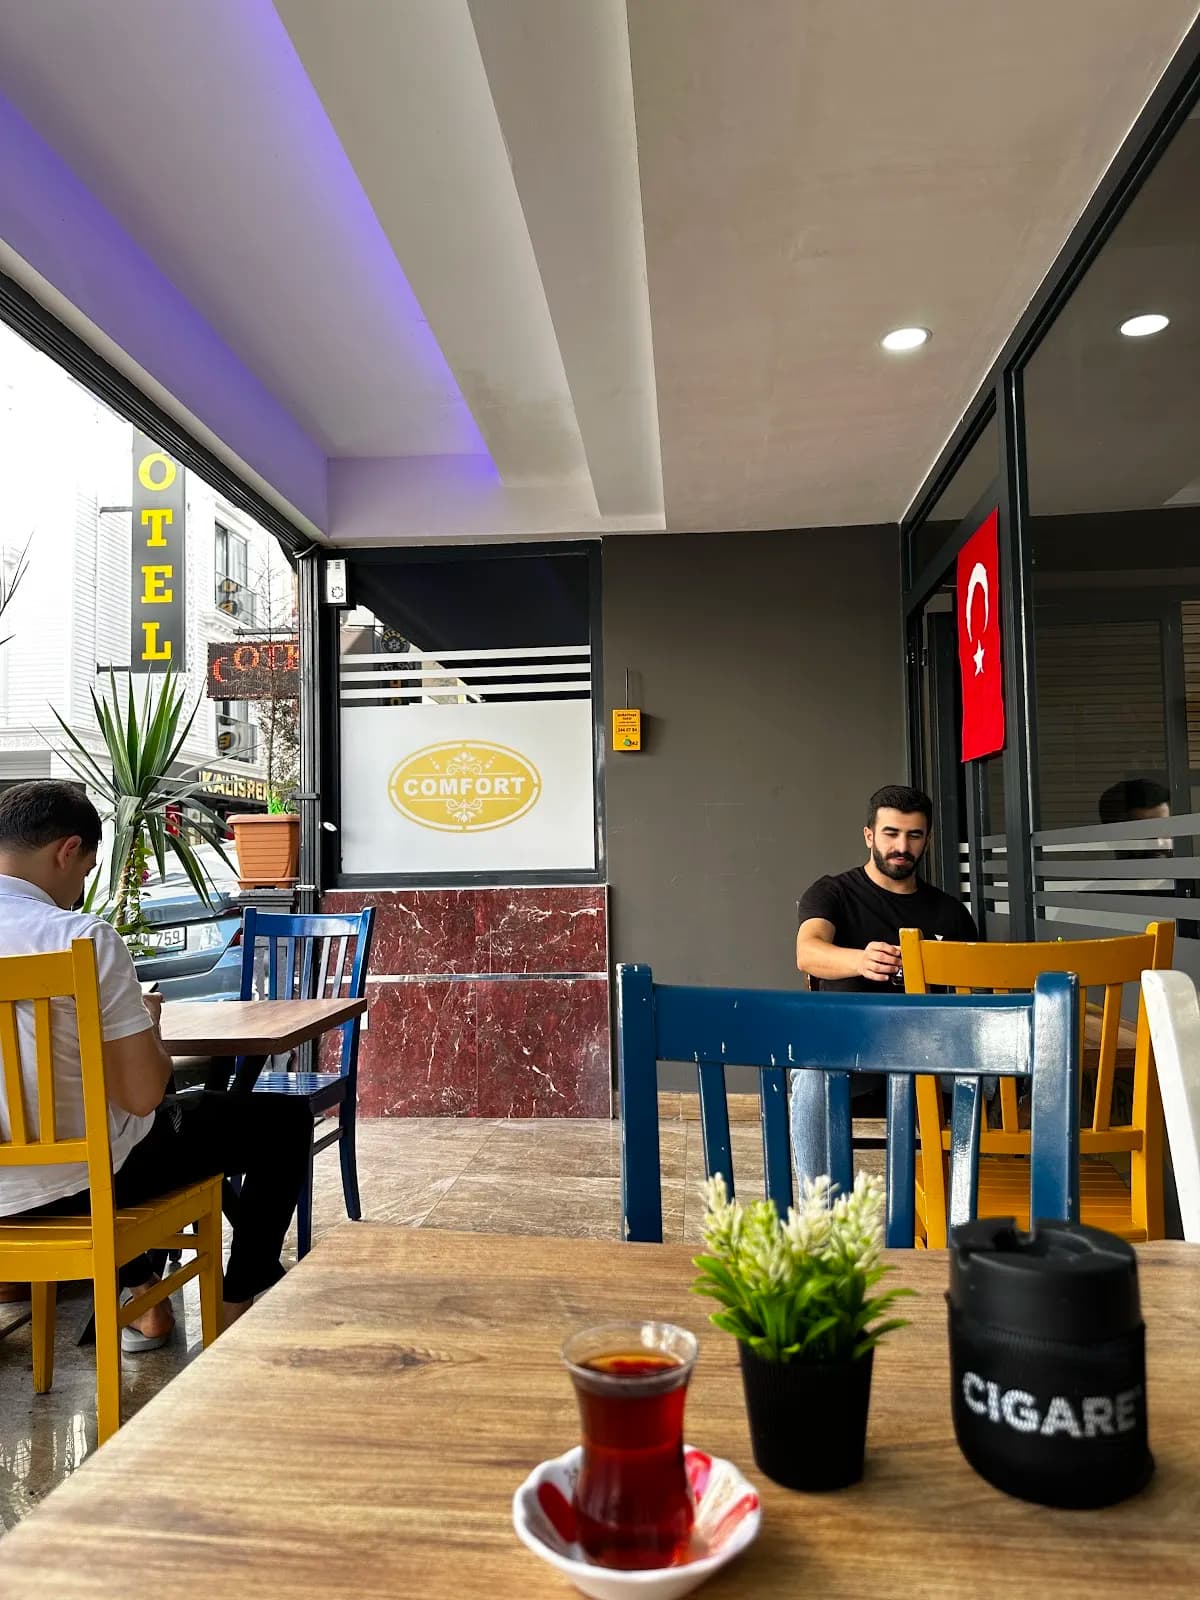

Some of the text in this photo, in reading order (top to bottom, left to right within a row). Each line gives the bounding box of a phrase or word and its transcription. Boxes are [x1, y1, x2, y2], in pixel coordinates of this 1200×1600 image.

[138, 431, 177, 661] OTEL
[403, 776, 526, 796] COMFORT
[156, 930, 180, 946] 759
[962, 1371, 1142, 1438] CIGARE
